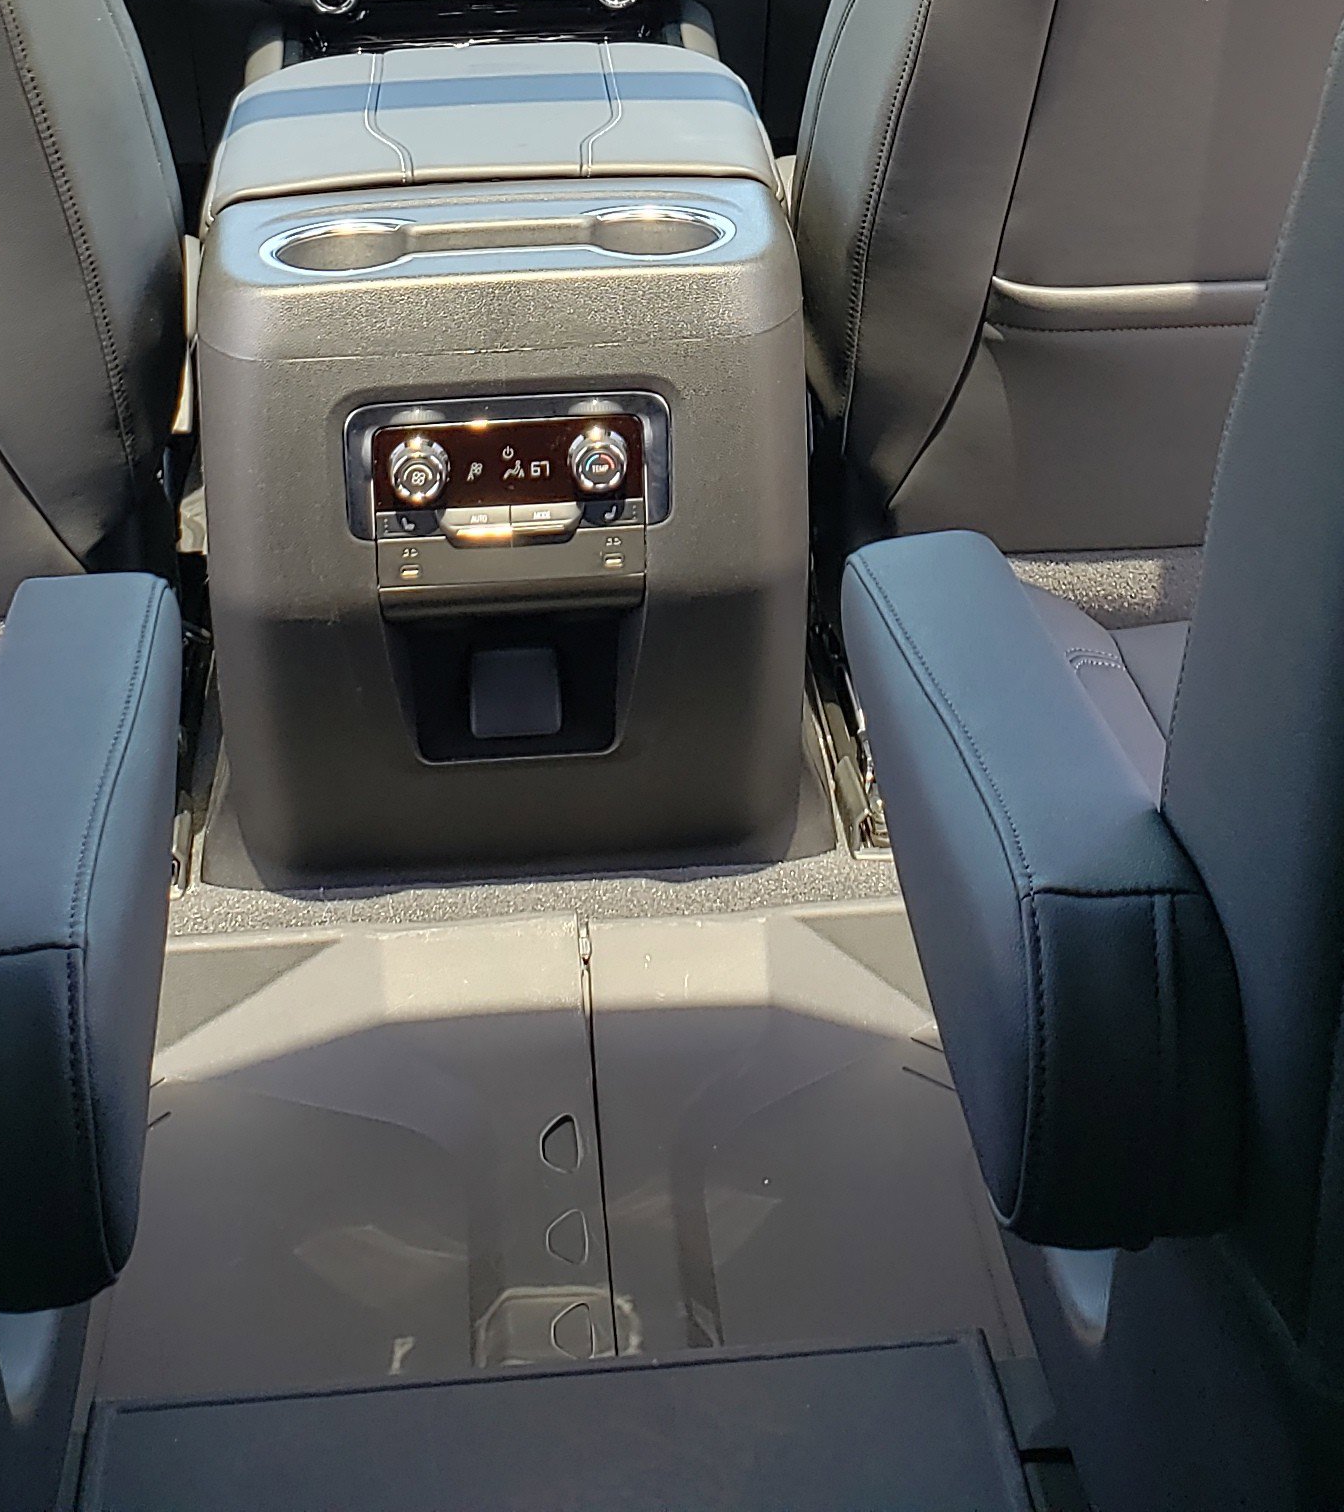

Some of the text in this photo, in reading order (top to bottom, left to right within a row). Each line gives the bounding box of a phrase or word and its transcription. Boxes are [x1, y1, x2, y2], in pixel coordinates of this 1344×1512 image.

[530, 461, 550, 477] 67
[592, 464, 609, 473] TEMP
[471, 515, 487, 523] AUTO
[533, 511, 551, 520] MODE
